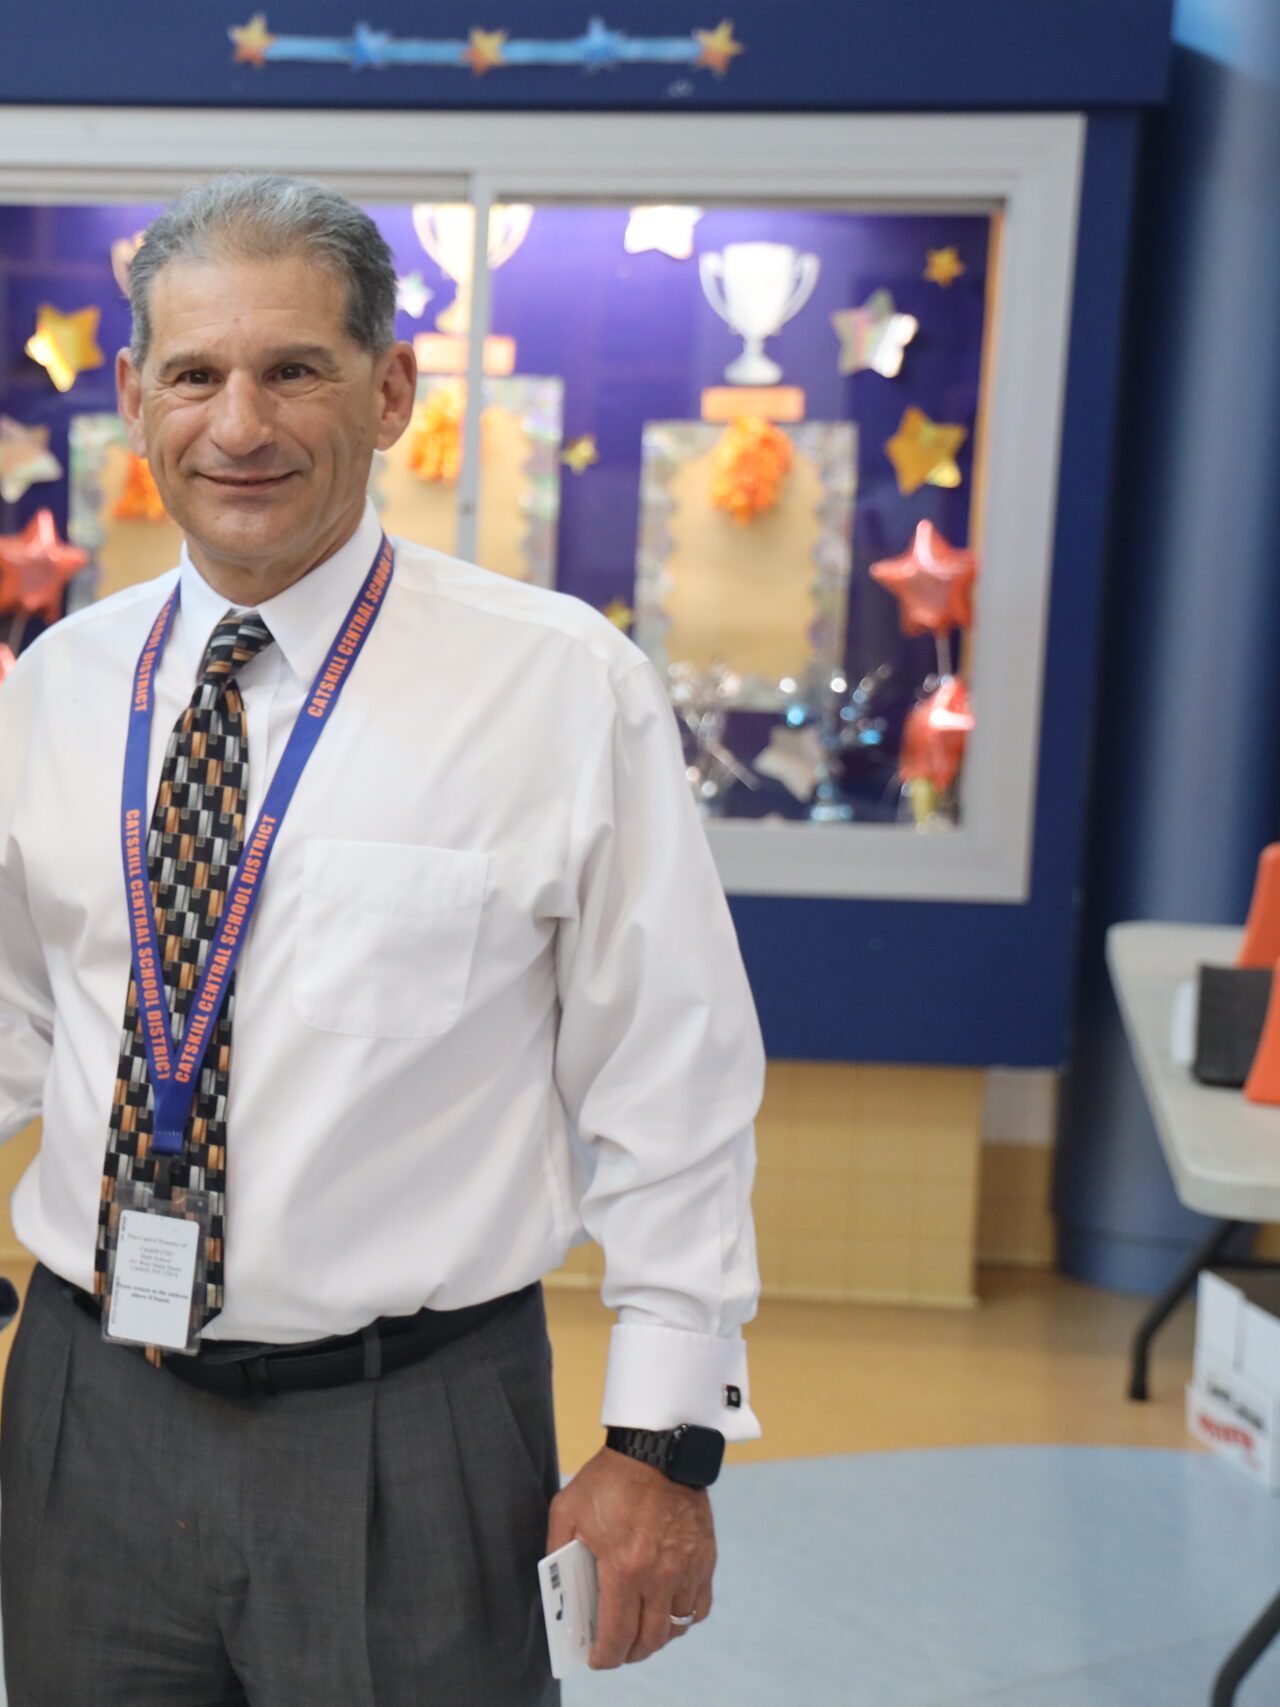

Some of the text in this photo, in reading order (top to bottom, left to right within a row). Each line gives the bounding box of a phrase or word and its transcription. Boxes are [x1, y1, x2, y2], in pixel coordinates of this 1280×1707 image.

[134, 651, 156, 711] DISTRICT
[308, 555, 392, 717] CATSKILL CENTRAL SCHOOL
[126, 809, 171, 1080] CATSKILL CENTRAL SCHOOL DISTRICT
[175, 814, 277, 1083] CATSKILL CENTRAL SCHOOL DISTRICT
